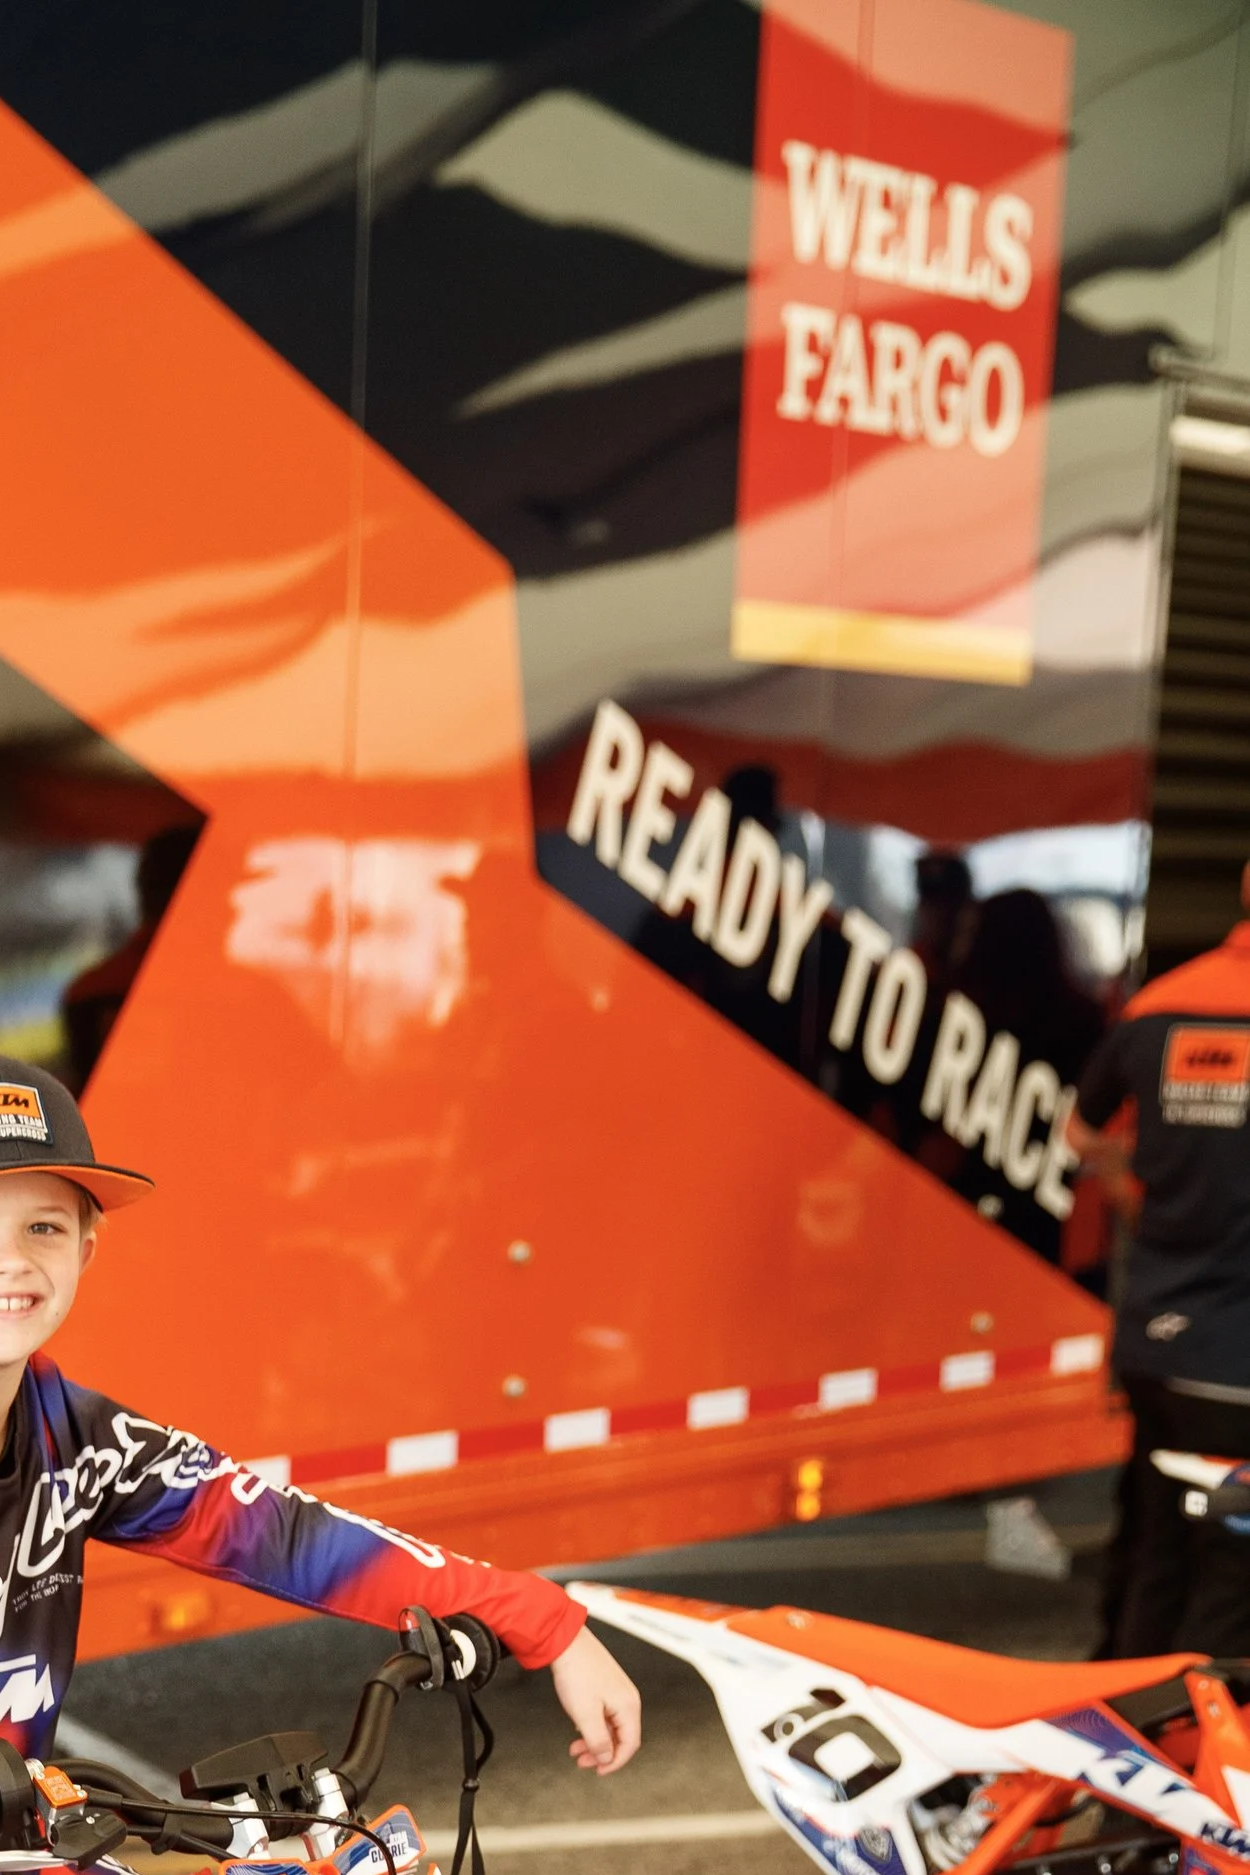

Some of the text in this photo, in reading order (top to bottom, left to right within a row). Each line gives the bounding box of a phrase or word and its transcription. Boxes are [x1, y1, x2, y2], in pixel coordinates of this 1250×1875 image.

[782, 139, 1033, 311] WELLS
[777, 302, 1025, 457] FARGO
[567, 699, 1082, 1221] READY TO RACE
[18, 1114, 43, 1127] TEAM
[371, 1841, 407, 1863] CURIE
